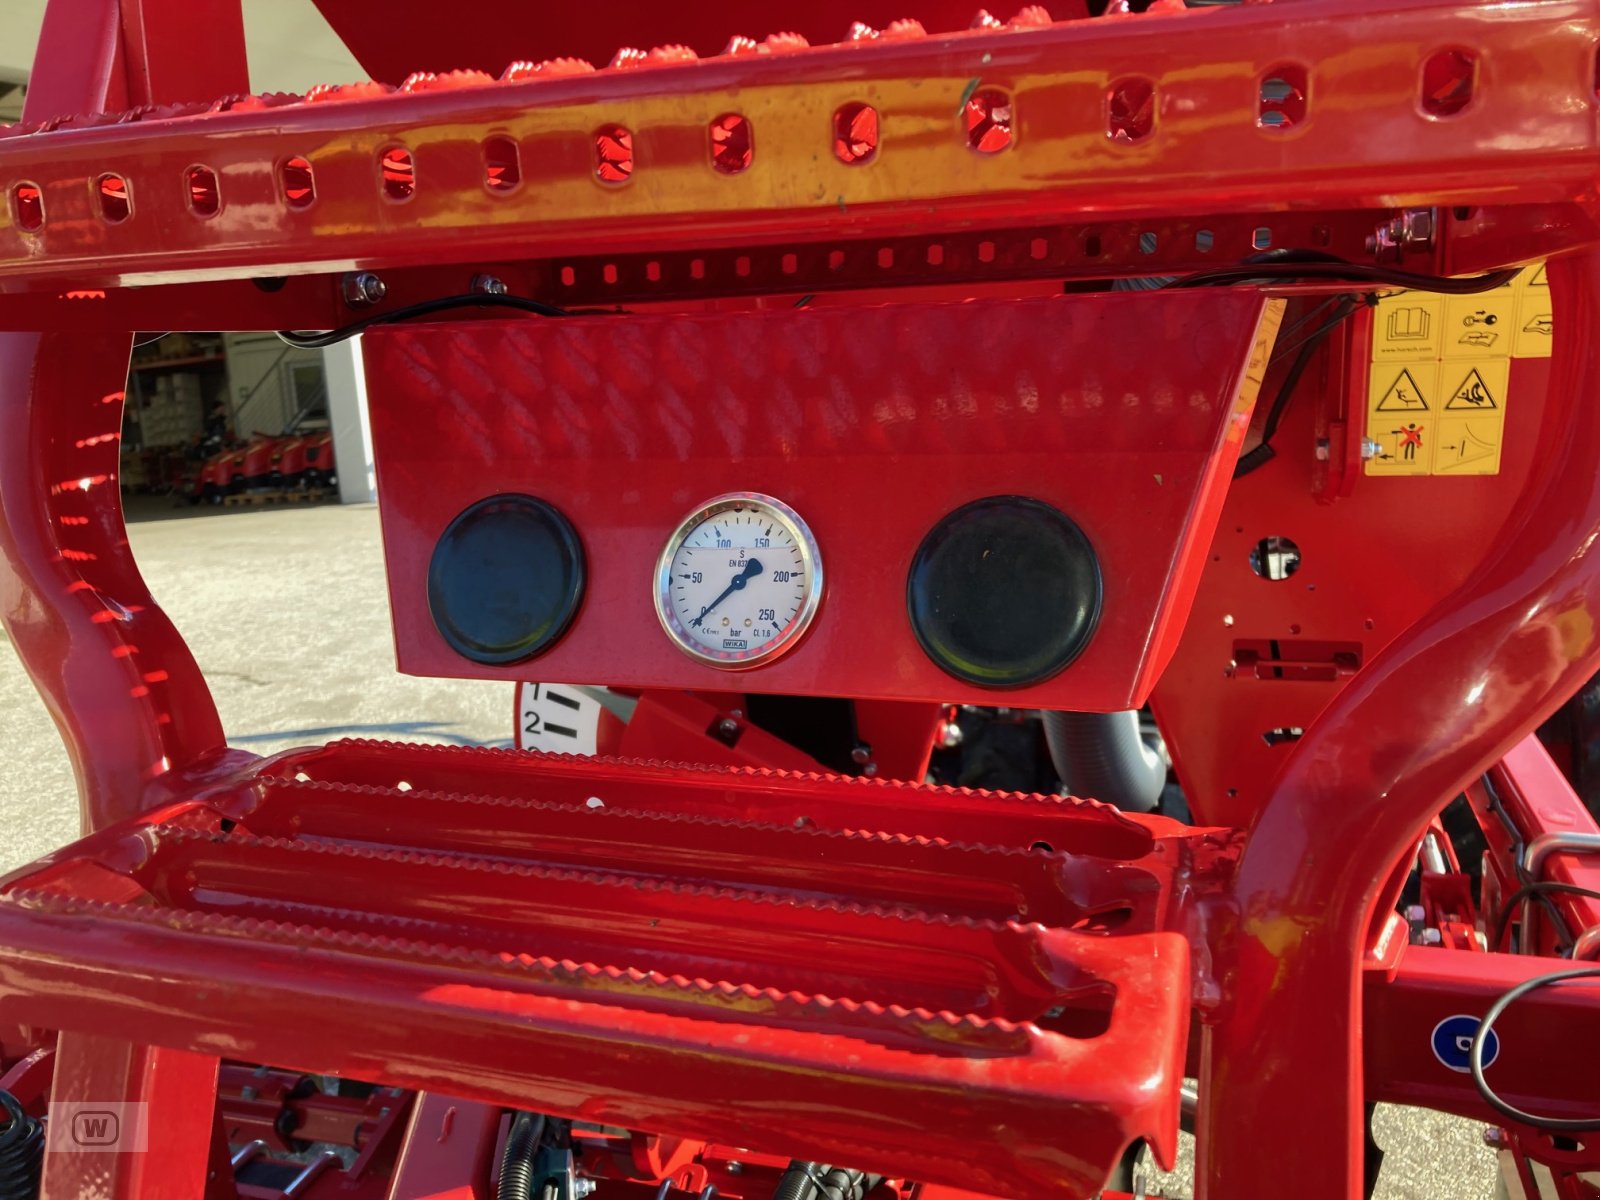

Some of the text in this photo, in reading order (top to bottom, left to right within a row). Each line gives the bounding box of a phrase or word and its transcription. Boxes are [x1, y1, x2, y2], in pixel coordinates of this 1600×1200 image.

[716, 539, 732, 548] 100
[755, 538, 770, 548] 150
[729, 559, 737, 567] EN
[692, 572, 703, 583] 50
[773, 571, 790, 583] 200
[758, 609, 775, 621] 250
[730, 628, 742, 637] bar
[725, 640, 743, 648] WIKA
[524, 710, 541, 735] 2
